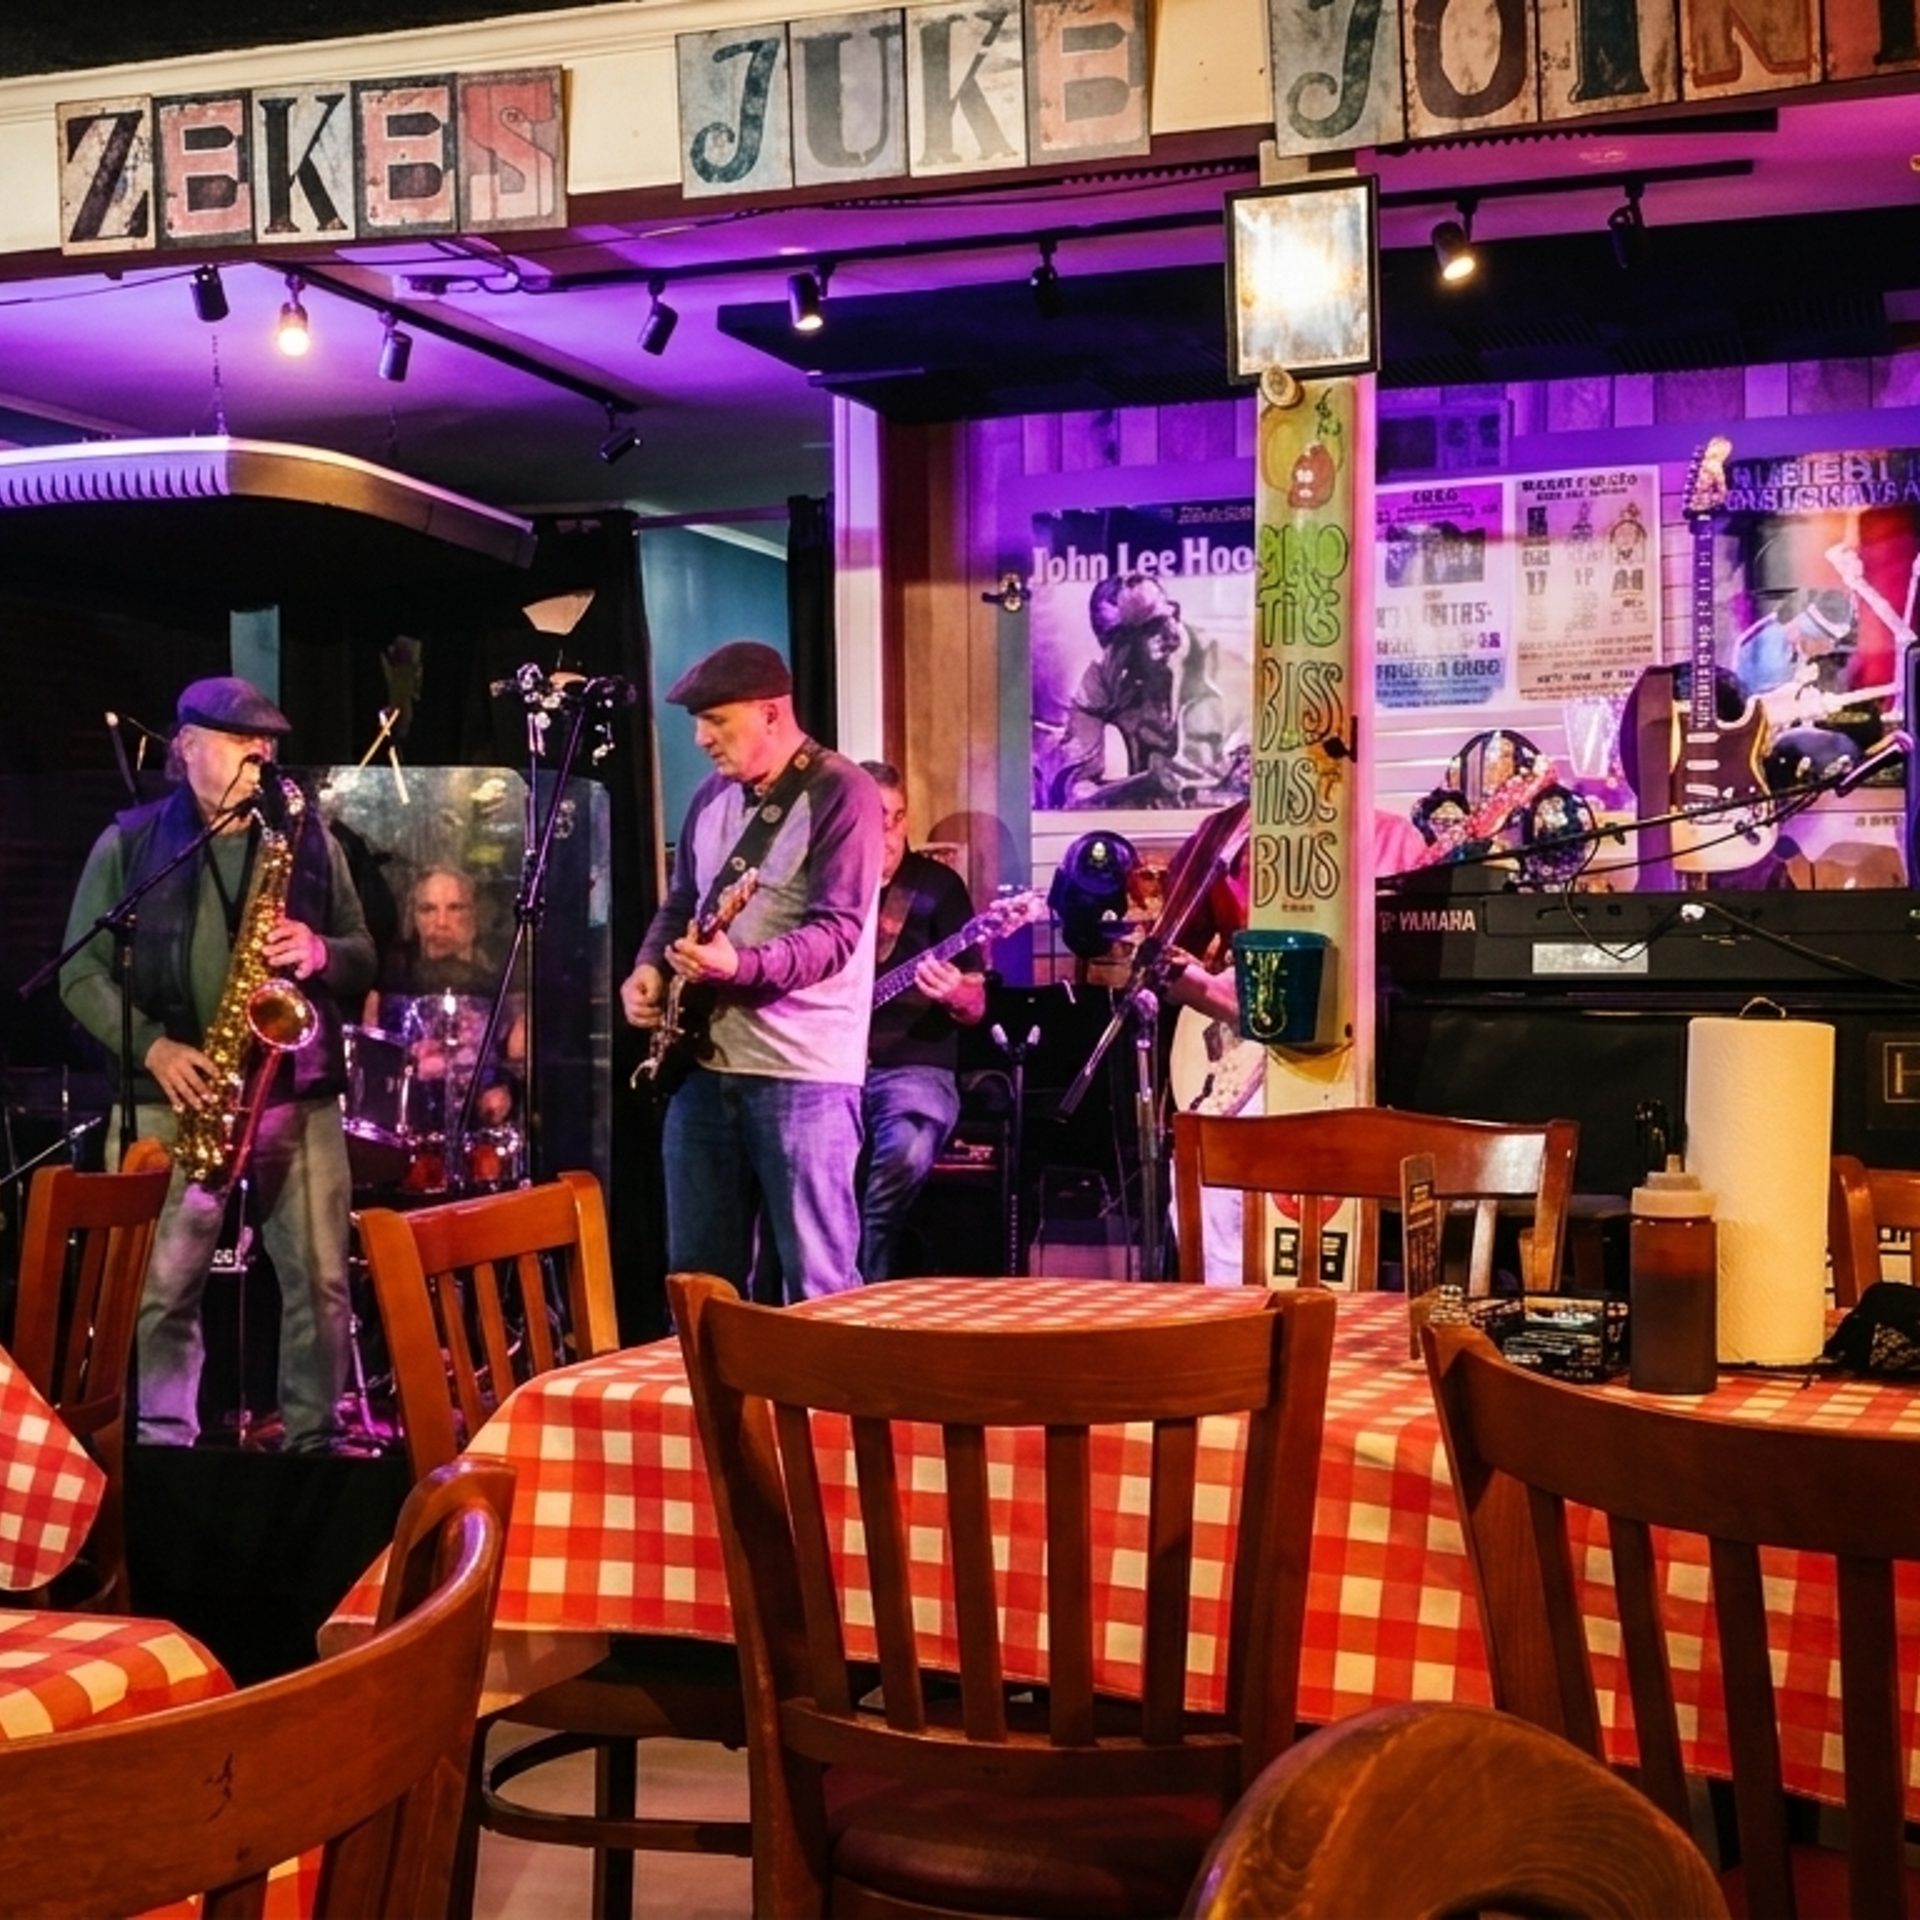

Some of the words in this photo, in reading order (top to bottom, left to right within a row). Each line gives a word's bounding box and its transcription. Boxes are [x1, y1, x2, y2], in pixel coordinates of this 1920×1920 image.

[66, 82, 556, 243] ZEKES
[689, 4, 1144, 183] JUKE
[1027, 545, 1109, 584] John
[1117, 541, 1177, 579] Lee
[1253, 831, 1341, 908] BUS
